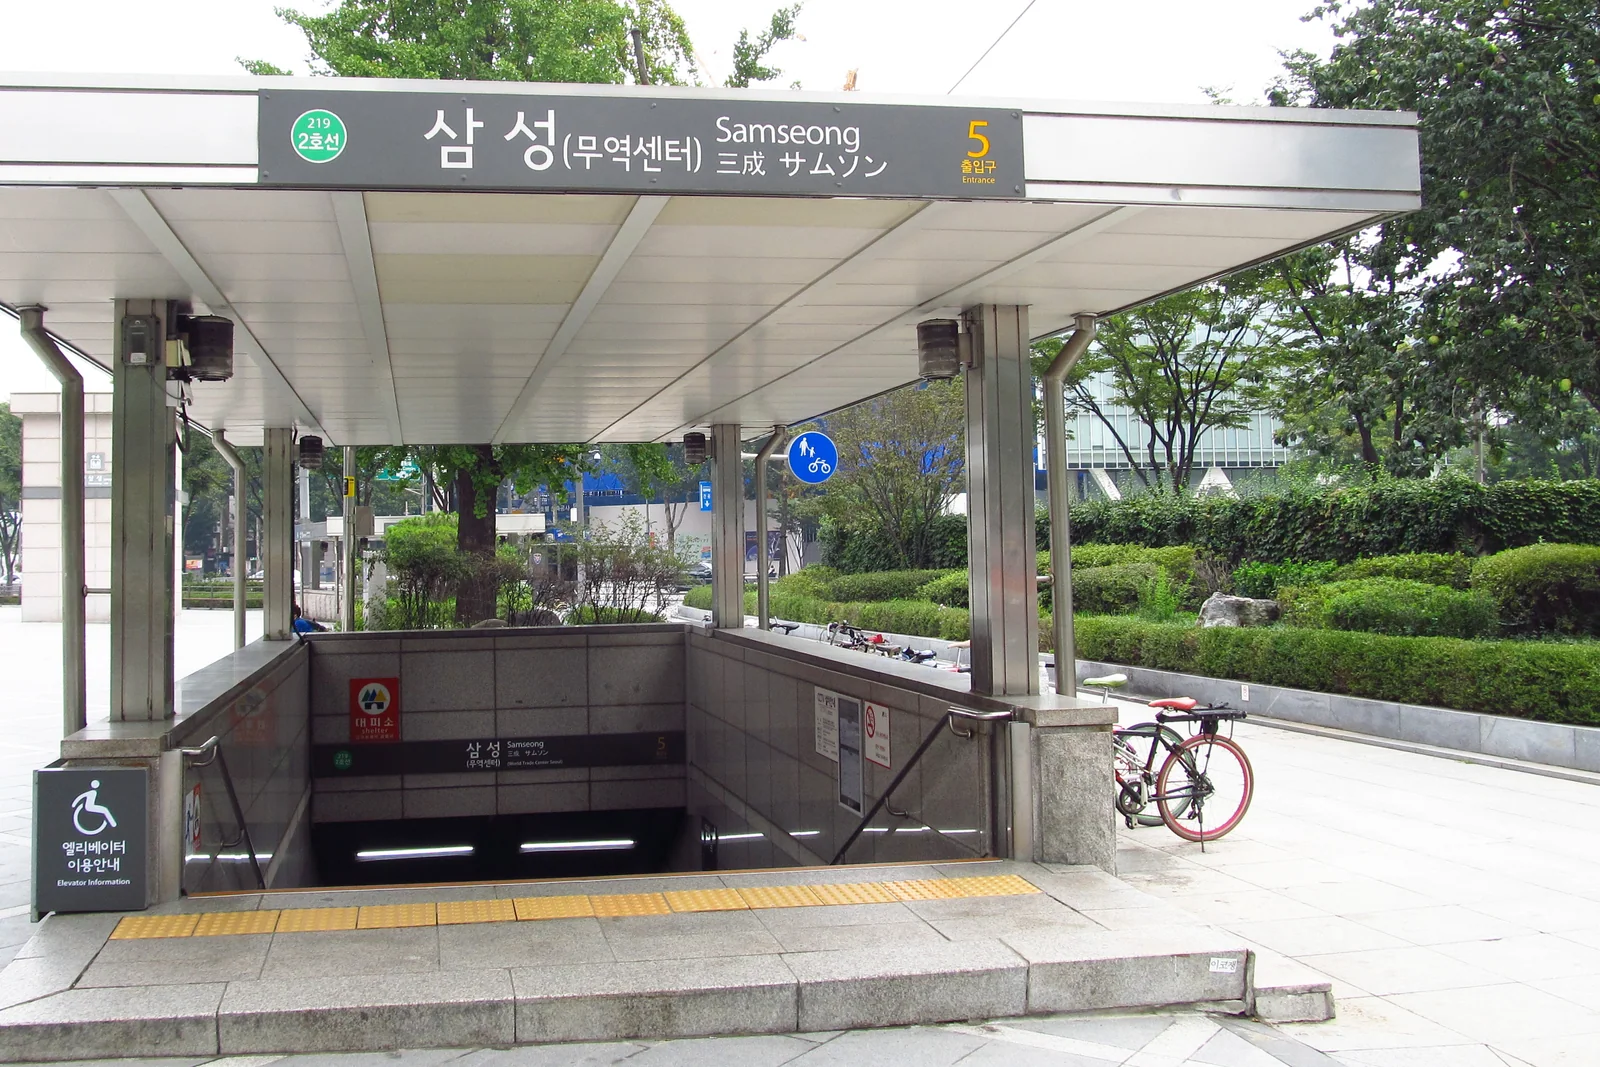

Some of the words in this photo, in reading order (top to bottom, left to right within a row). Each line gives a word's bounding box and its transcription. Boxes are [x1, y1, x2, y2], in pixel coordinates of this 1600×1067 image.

[307, 117, 331, 129] 219
[298, 132, 340, 150] 2호선
[716, 116, 860, 152] Samseong
[967, 119, 990, 158] 5
[563, 133, 702, 173] (무역센터)
[716, 151, 766, 176] 三成
[779, 152, 888, 178] サムソン
[961, 159, 997, 174] 출입구
[962, 175, 996, 184] Entrance
[361, 727, 389, 735] shelter
[507, 740, 544, 749] Samseong
[657, 736, 666, 751] 5
[466, 758, 501, 769] (무역센터)
[62, 840, 126, 856] 엘리베이터
[67, 857, 120, 873] 이용안내
[57, 878, 87, 887] Elevator
[88, 878, 131, 887] Information
